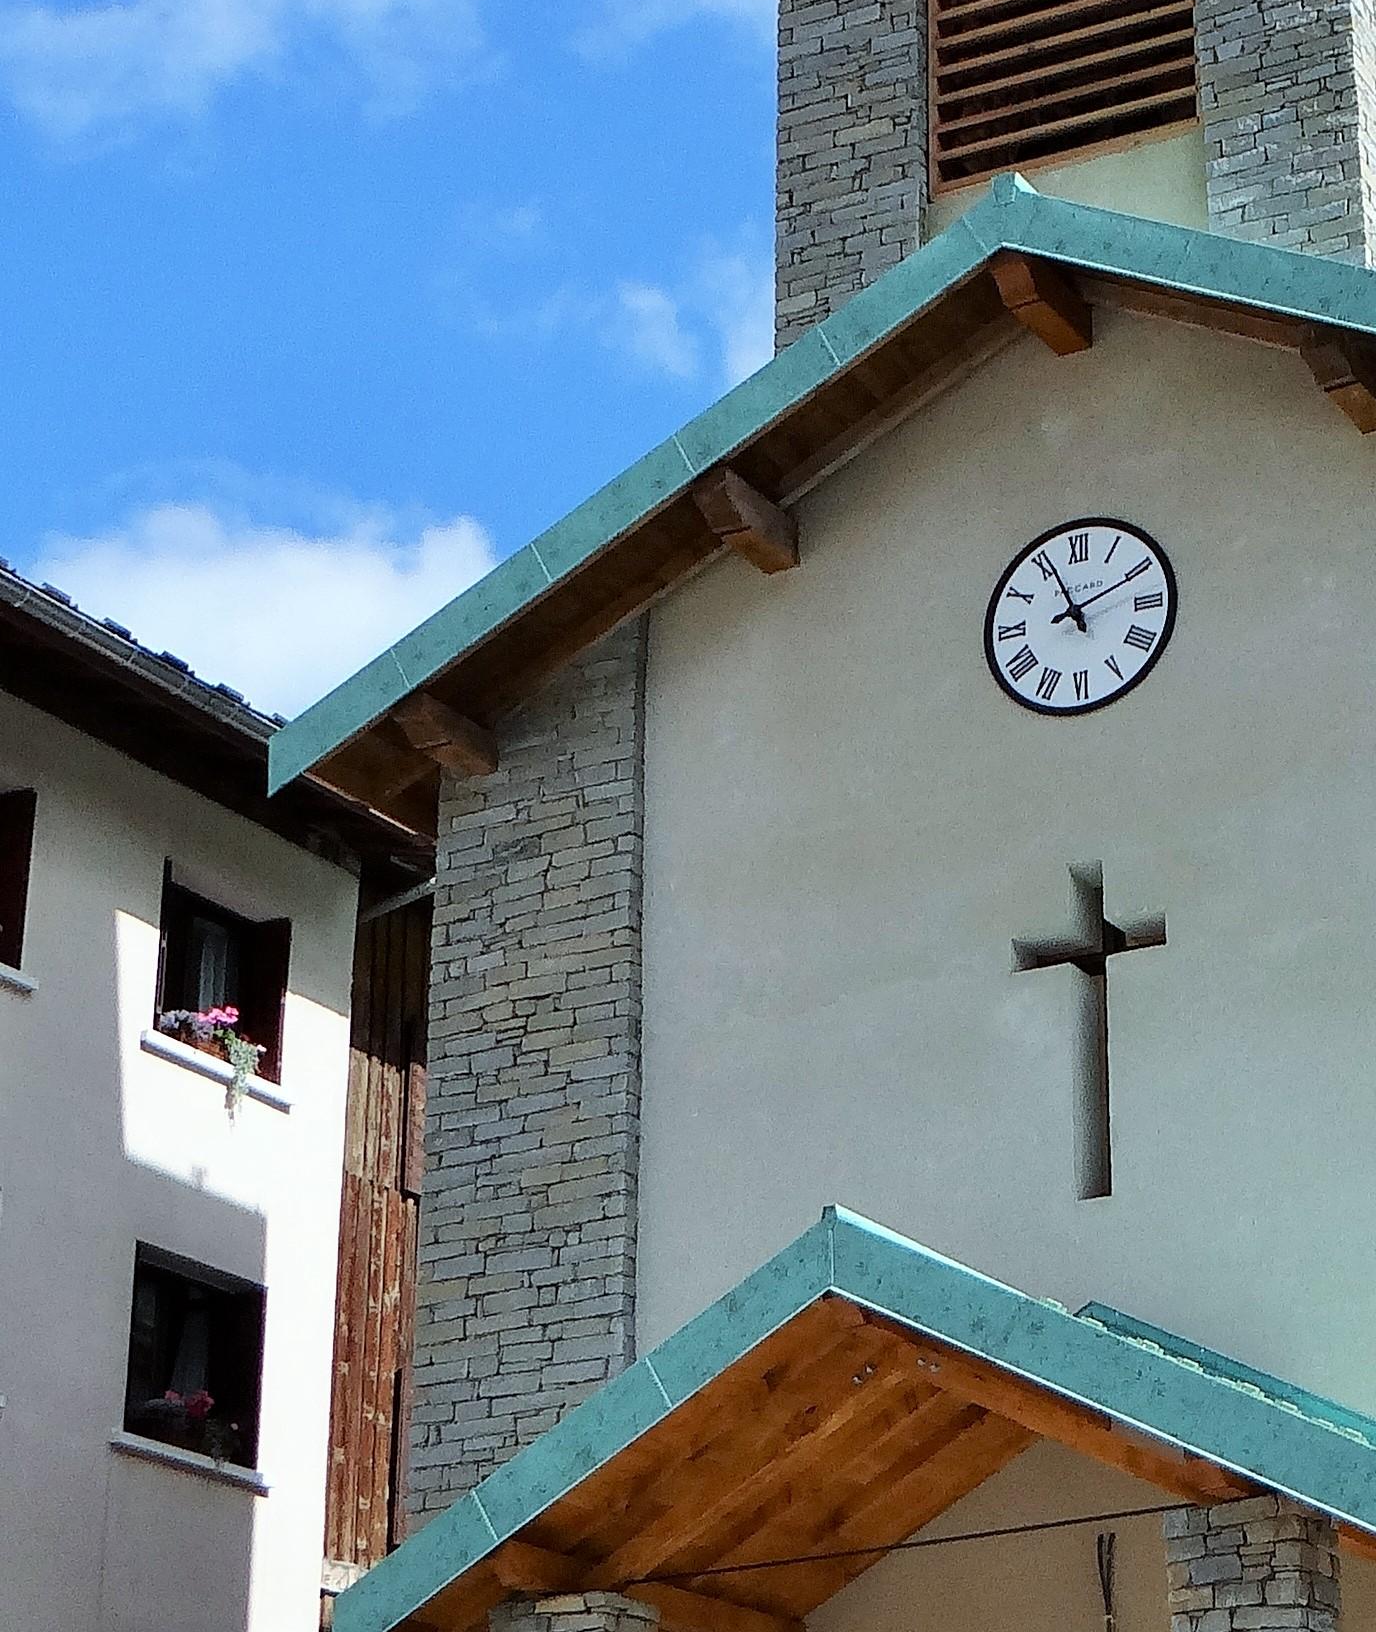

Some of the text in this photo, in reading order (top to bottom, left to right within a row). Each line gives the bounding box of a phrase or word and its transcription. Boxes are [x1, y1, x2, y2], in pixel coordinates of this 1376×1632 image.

[1068, 533, 1089, 565] XII
[1104, 536, 1121, 563] I
[1006, 586, 1034, 605] X
[1054, 580, 1103, 597] PCCARD
[1133, 591, 1163, 612] III
[998, 620, 1026, 642] IX
[1005, 644, 1039, 682] VIII
[1104, 655, 1124, 681] V
[1035, 667, 1063, 701] VII
[1073, 670, 1089, 701] VI
